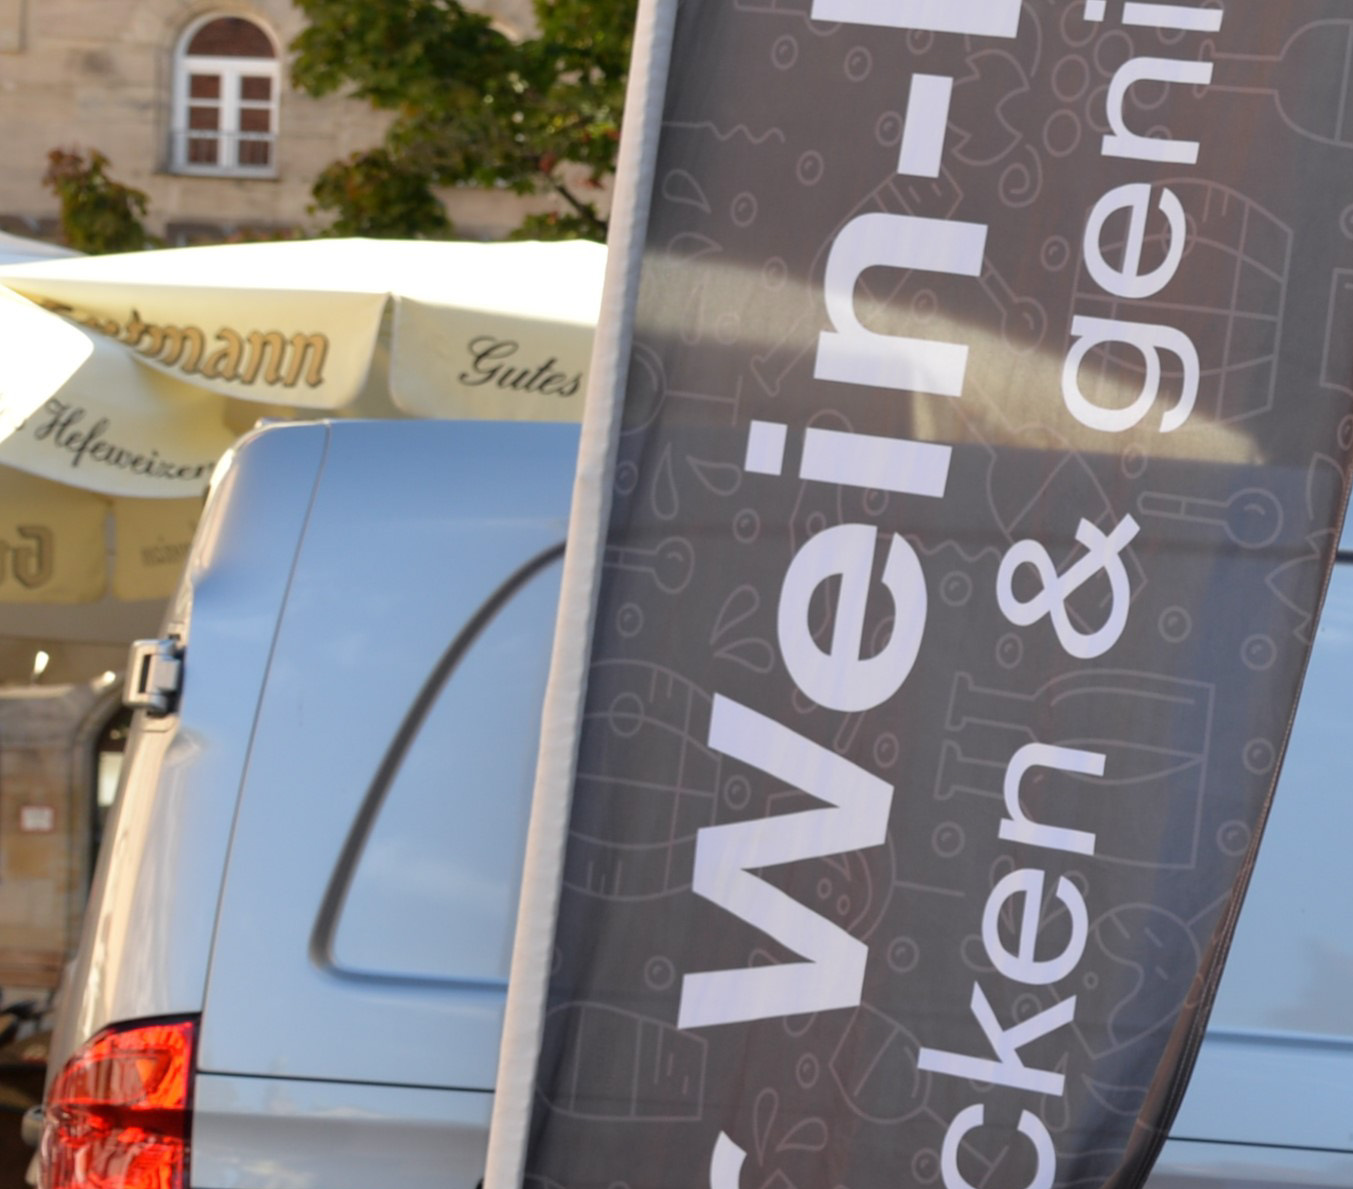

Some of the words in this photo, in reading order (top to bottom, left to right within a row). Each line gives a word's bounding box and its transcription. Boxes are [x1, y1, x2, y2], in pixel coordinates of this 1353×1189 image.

[42, 298, 330, 388] tmann
[458, 335, 587, 399] Gutes
[677, 0, 1018, 1029] Wein-
[996, 513, 1140, 660] &
